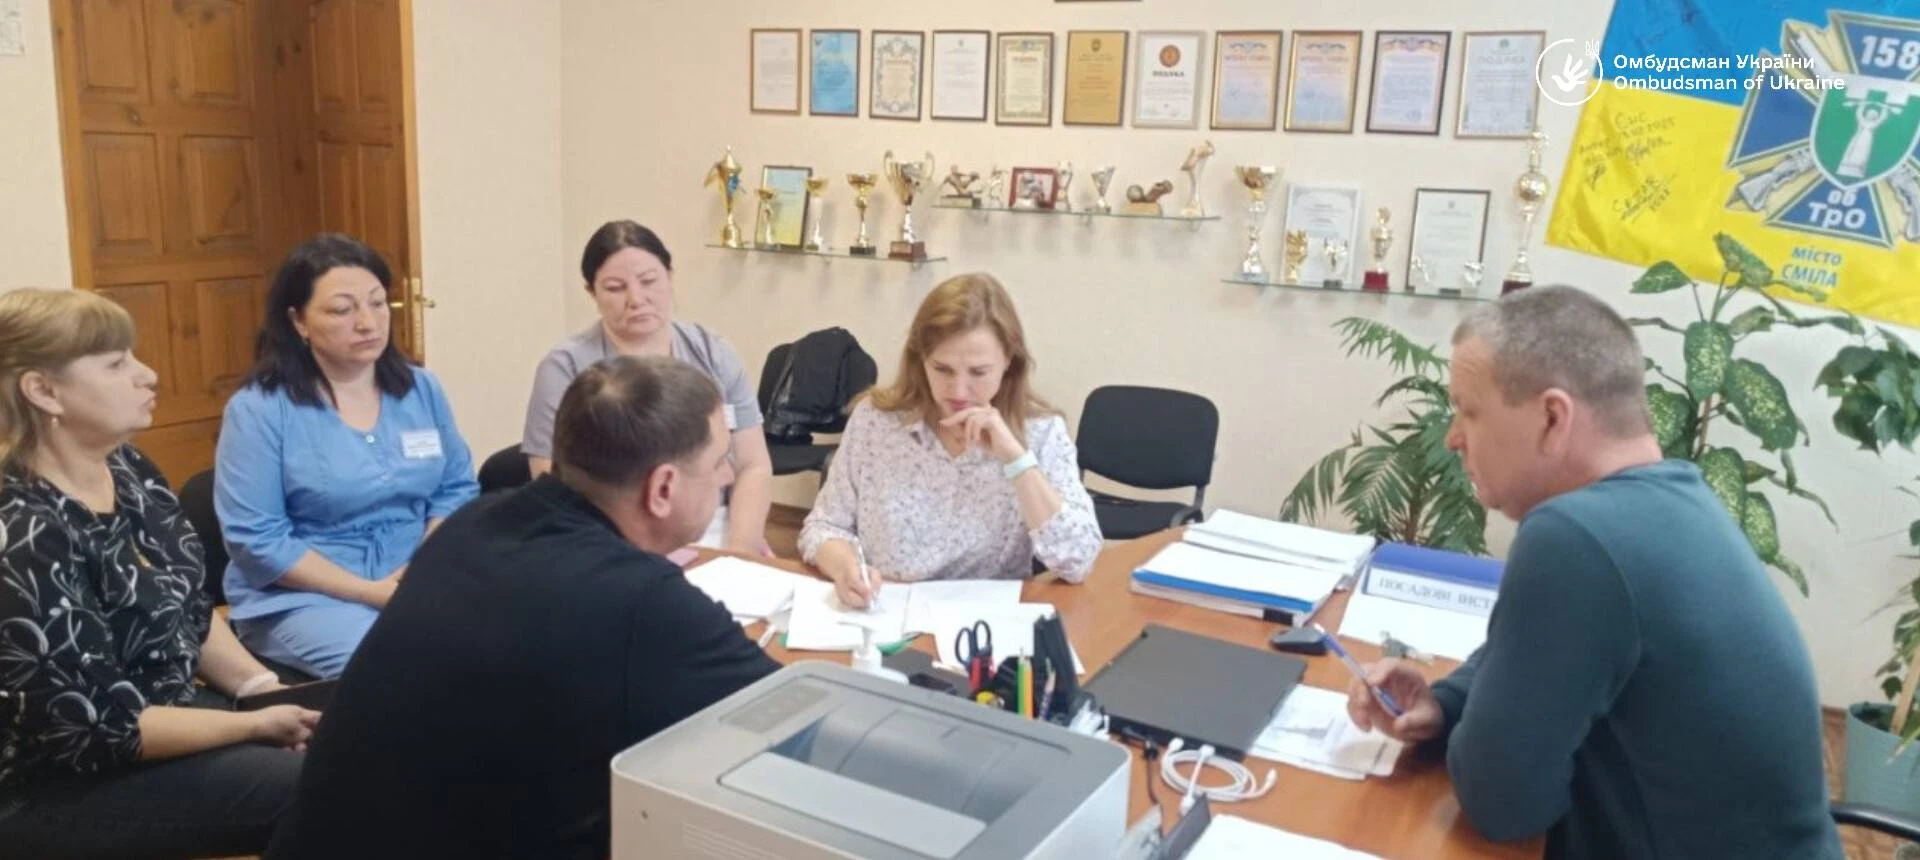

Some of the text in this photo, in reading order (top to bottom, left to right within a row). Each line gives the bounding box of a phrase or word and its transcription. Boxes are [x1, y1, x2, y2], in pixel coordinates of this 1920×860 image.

[1861, 35, 1920, 71] 158
[1827, 188, 1859, 207] об
[1808, 202, 1867, 229] ТрО
[1791, 247, 1842, 266] місто
[1781, 264, 1838, 287] СМІЛА
